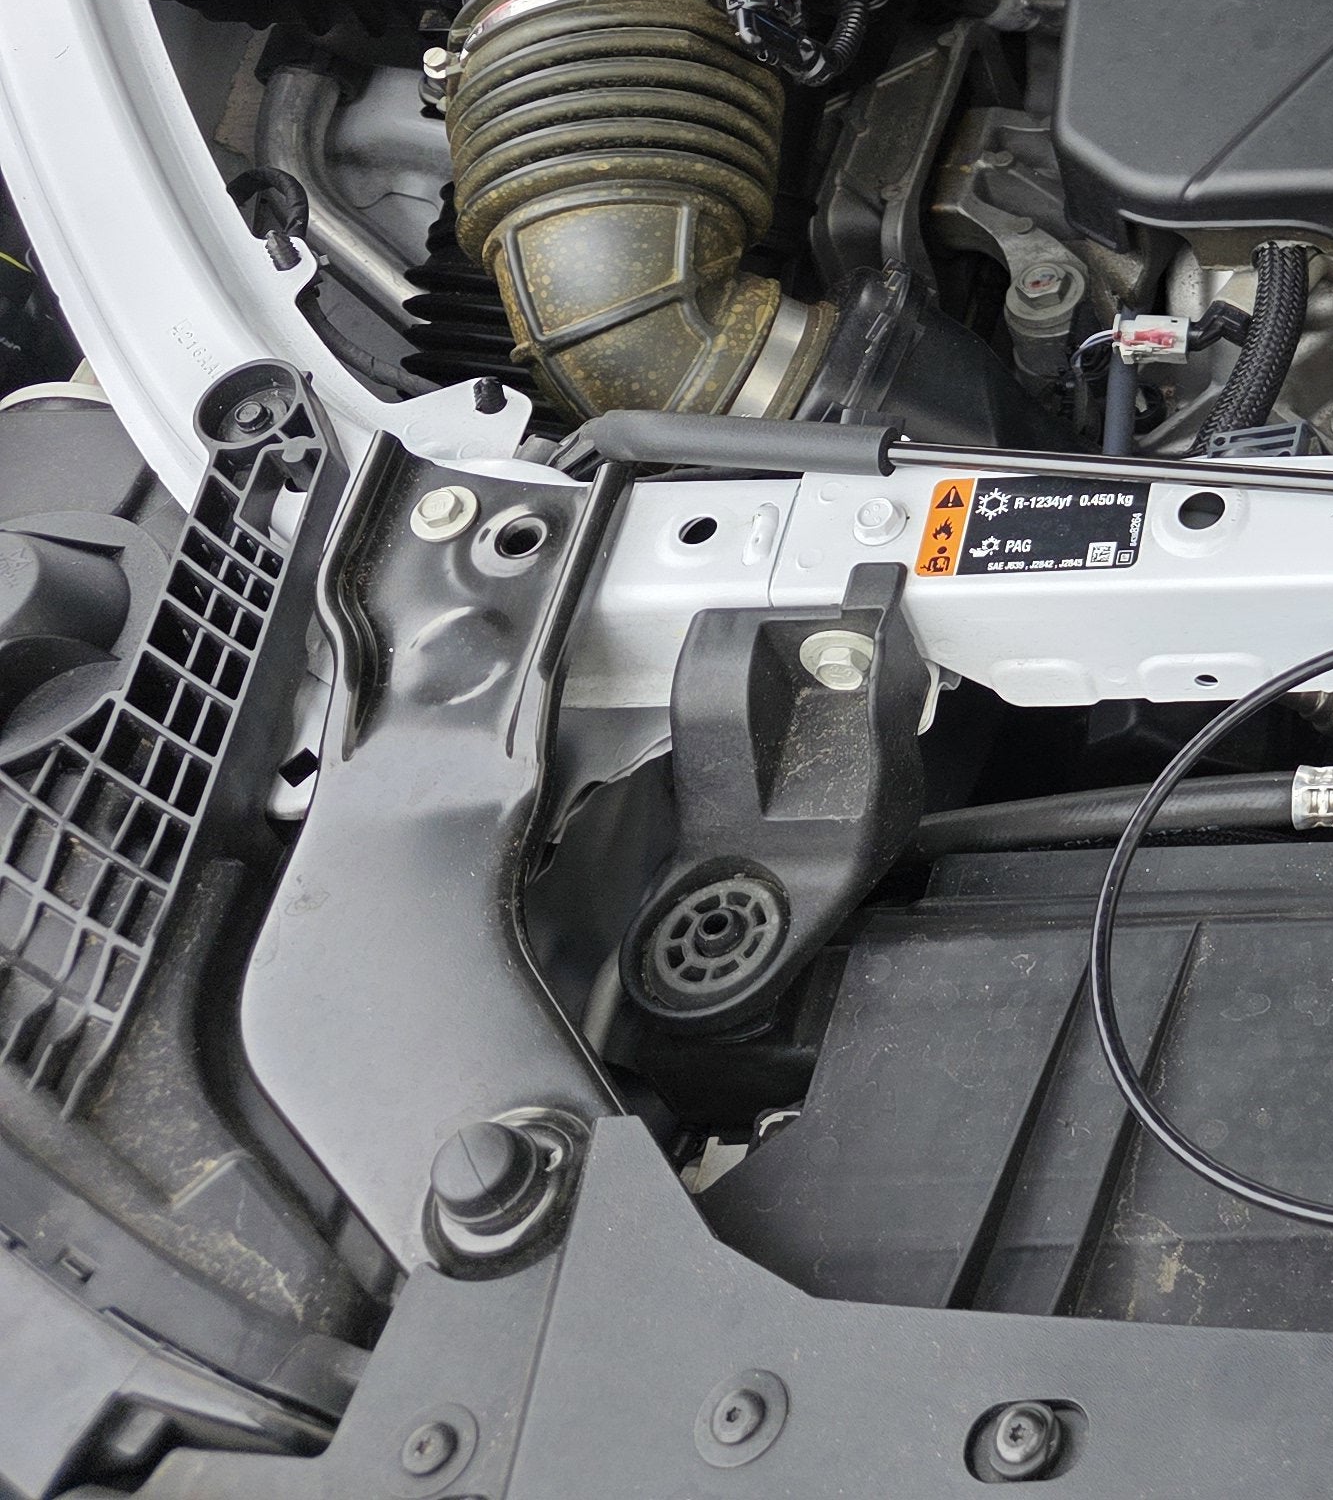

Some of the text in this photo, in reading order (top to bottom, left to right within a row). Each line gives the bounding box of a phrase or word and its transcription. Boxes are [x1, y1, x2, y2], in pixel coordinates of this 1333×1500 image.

[1013, 492, 1134, 510] R-1234yf 0.450 kg
[1005, 539, 1032, 554] PAG
[987, 561, 1004, 572] SAE
